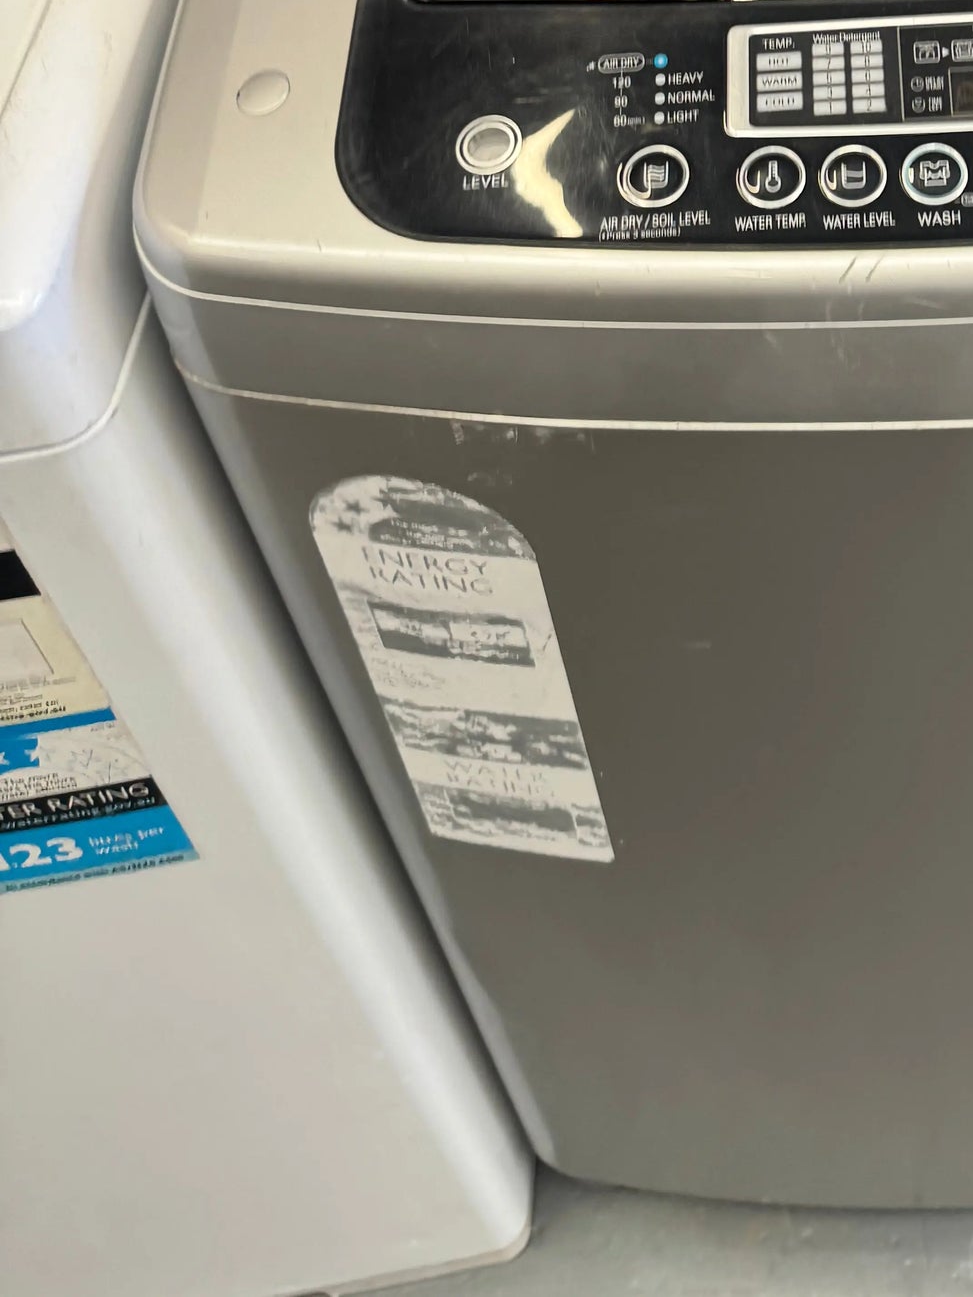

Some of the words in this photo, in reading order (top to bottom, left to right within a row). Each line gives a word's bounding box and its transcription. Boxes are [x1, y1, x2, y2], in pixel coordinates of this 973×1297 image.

[812, 33, 838, 45] Water
[839, 31, 881, 43] Detergent
[602, 58, 620, 70] AIR
[620, 56, 641, 68] DRY
[667, 71, 704, 85] HEAVY
[762, 76, 797, 86] WARM
[667, 89, 715, 105] NORMAL
[667, 109, 699, 124] LIGHT
[463, 174, 509, 191] LEVEL
[600, 215, 619, 232] AIR
[621, 213, 643, 230] DRY
[652, 212, 677, 229] SOIL
[679, 209, 711, 226] LEVEL
[734, 216, 773, 232] WATER
[823, 213, 861, 230] WATER
[864, 210, 896, 228] LEVEL
[917, 210, 962, 227] WASH
[47, 781, 149, 811] RATING
